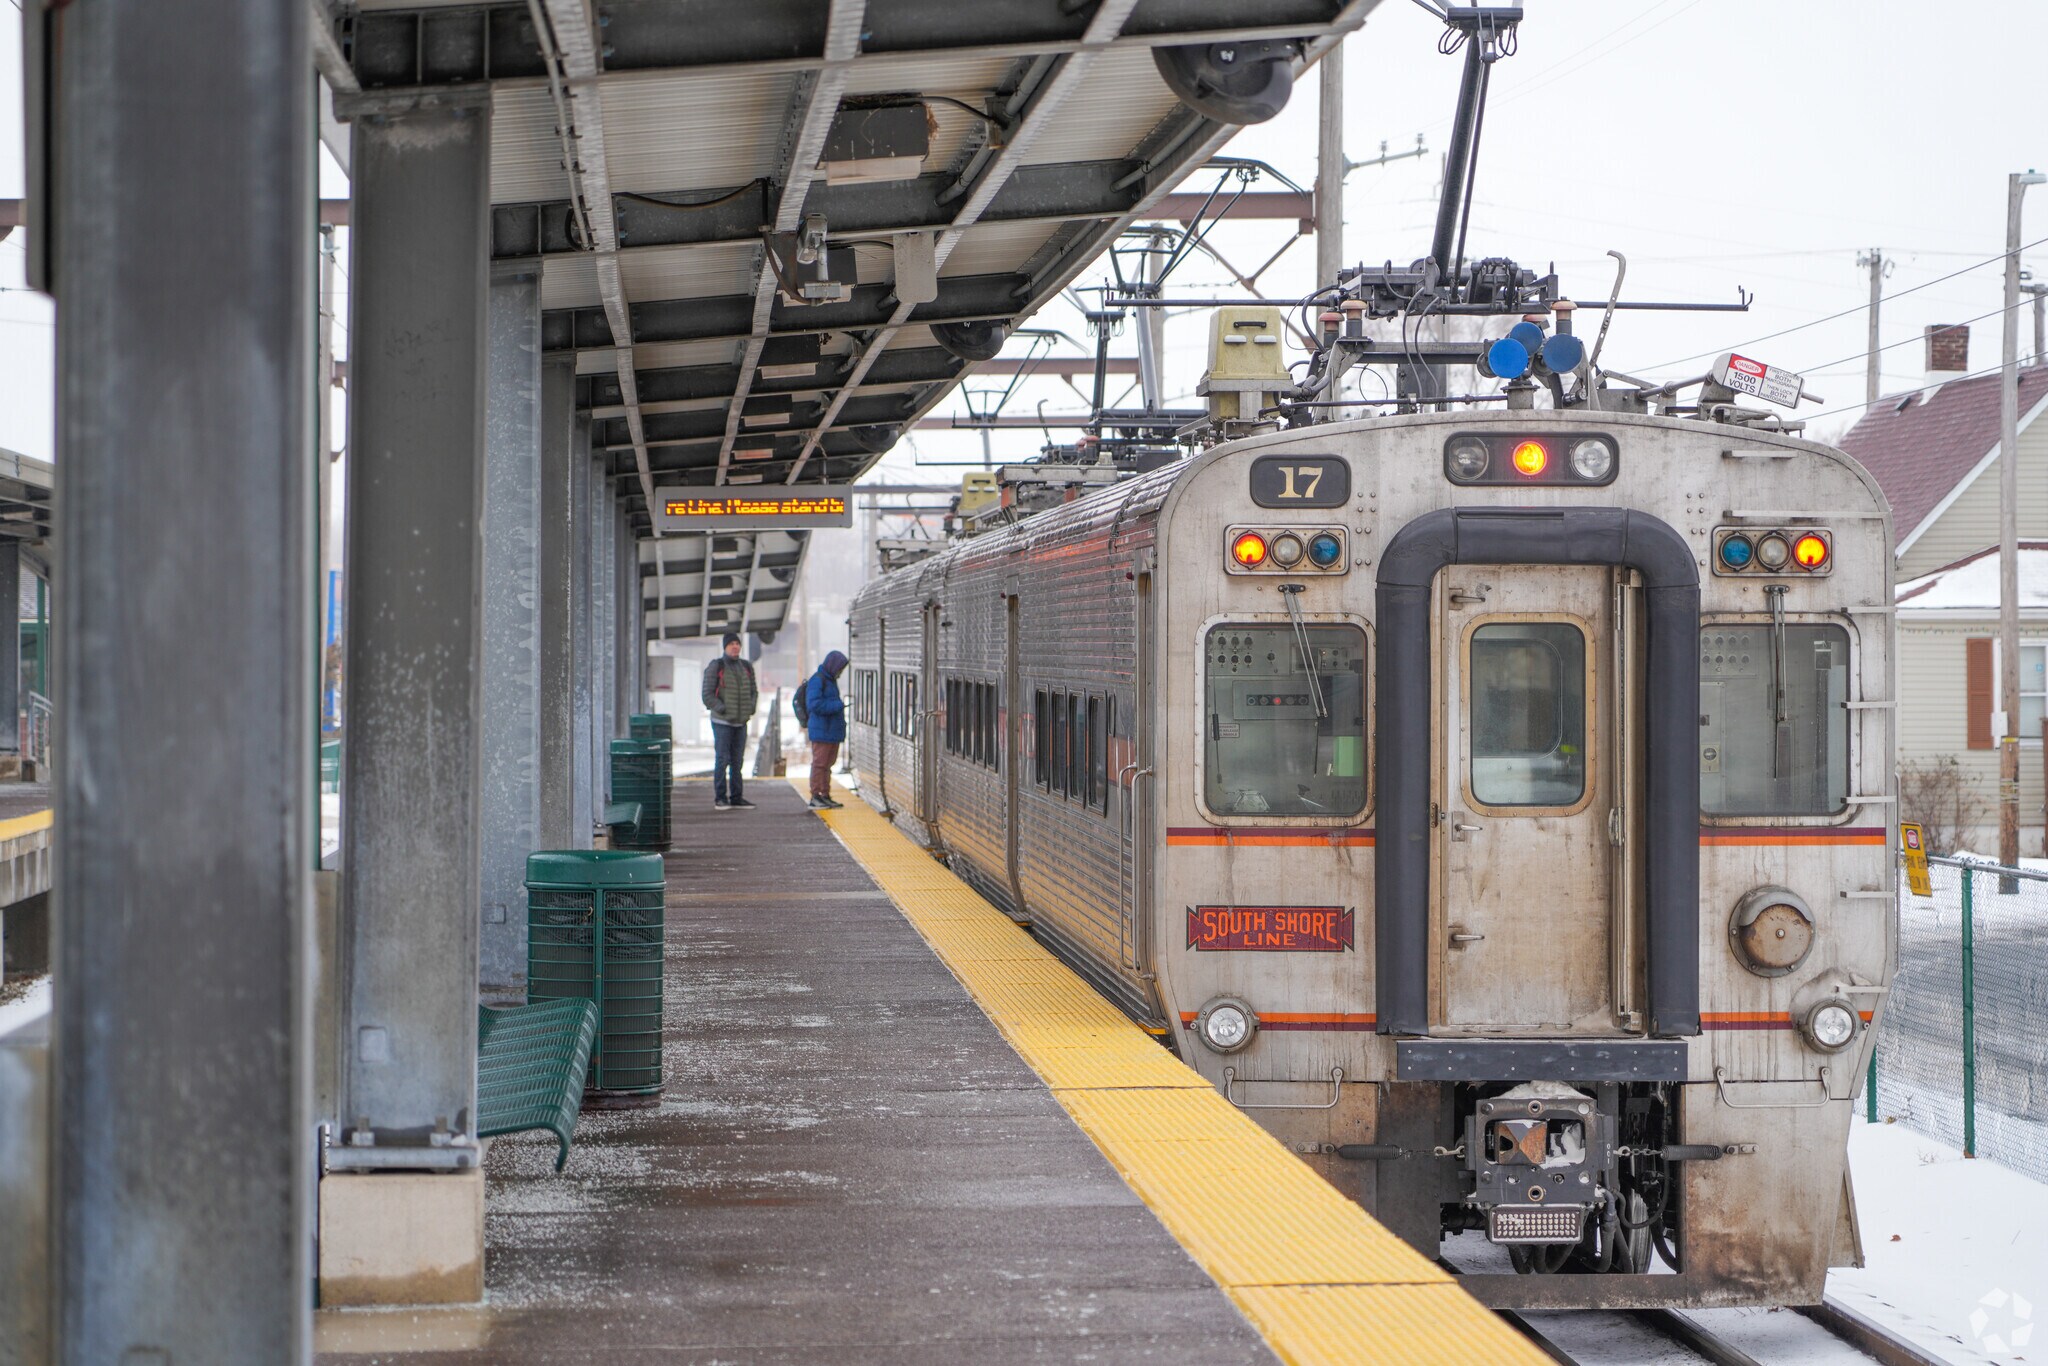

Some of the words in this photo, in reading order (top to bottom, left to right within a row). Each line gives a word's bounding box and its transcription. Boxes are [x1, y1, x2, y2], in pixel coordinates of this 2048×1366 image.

[1736, 360, 1760, 372] DANGER
[1734, 371, 1757, 385] 1500
[1774, 374, 1792, 384] BOTH
[1729, 378, 1756, 394] VOLTS
[1769, 390, 1788, 400] BOTH
[1278, 466, 1323, 498] 17
[1203, 911, 1266, 942] SOUTH
[1275, 912, 1337, 944] SHORE
[1243, 933, 1296, 946] LINE
